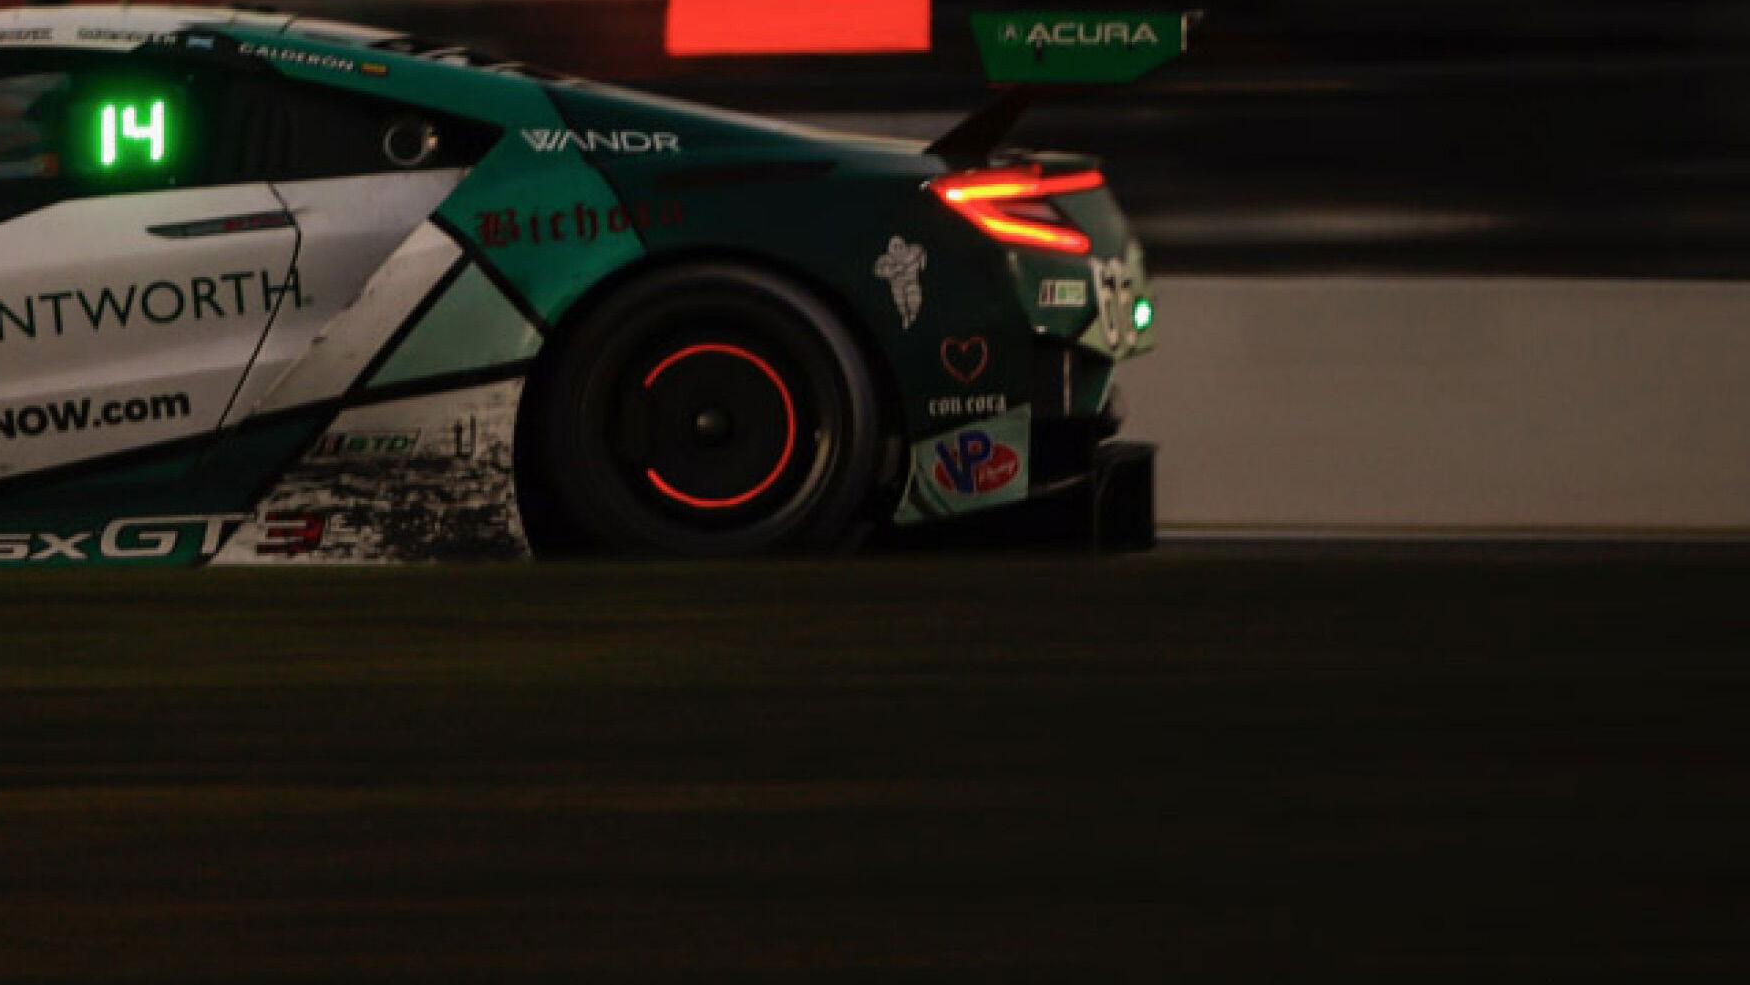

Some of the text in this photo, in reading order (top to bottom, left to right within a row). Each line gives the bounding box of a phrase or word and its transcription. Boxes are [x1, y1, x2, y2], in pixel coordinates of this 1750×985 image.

[1027, 20, 1159, 45] ACURA
[98, 99, 167, 167] 14
[520, 128, 682, 152] WANDR
[935, 430, 992, 494] VP
[99, 512, 327, 558] GT3
